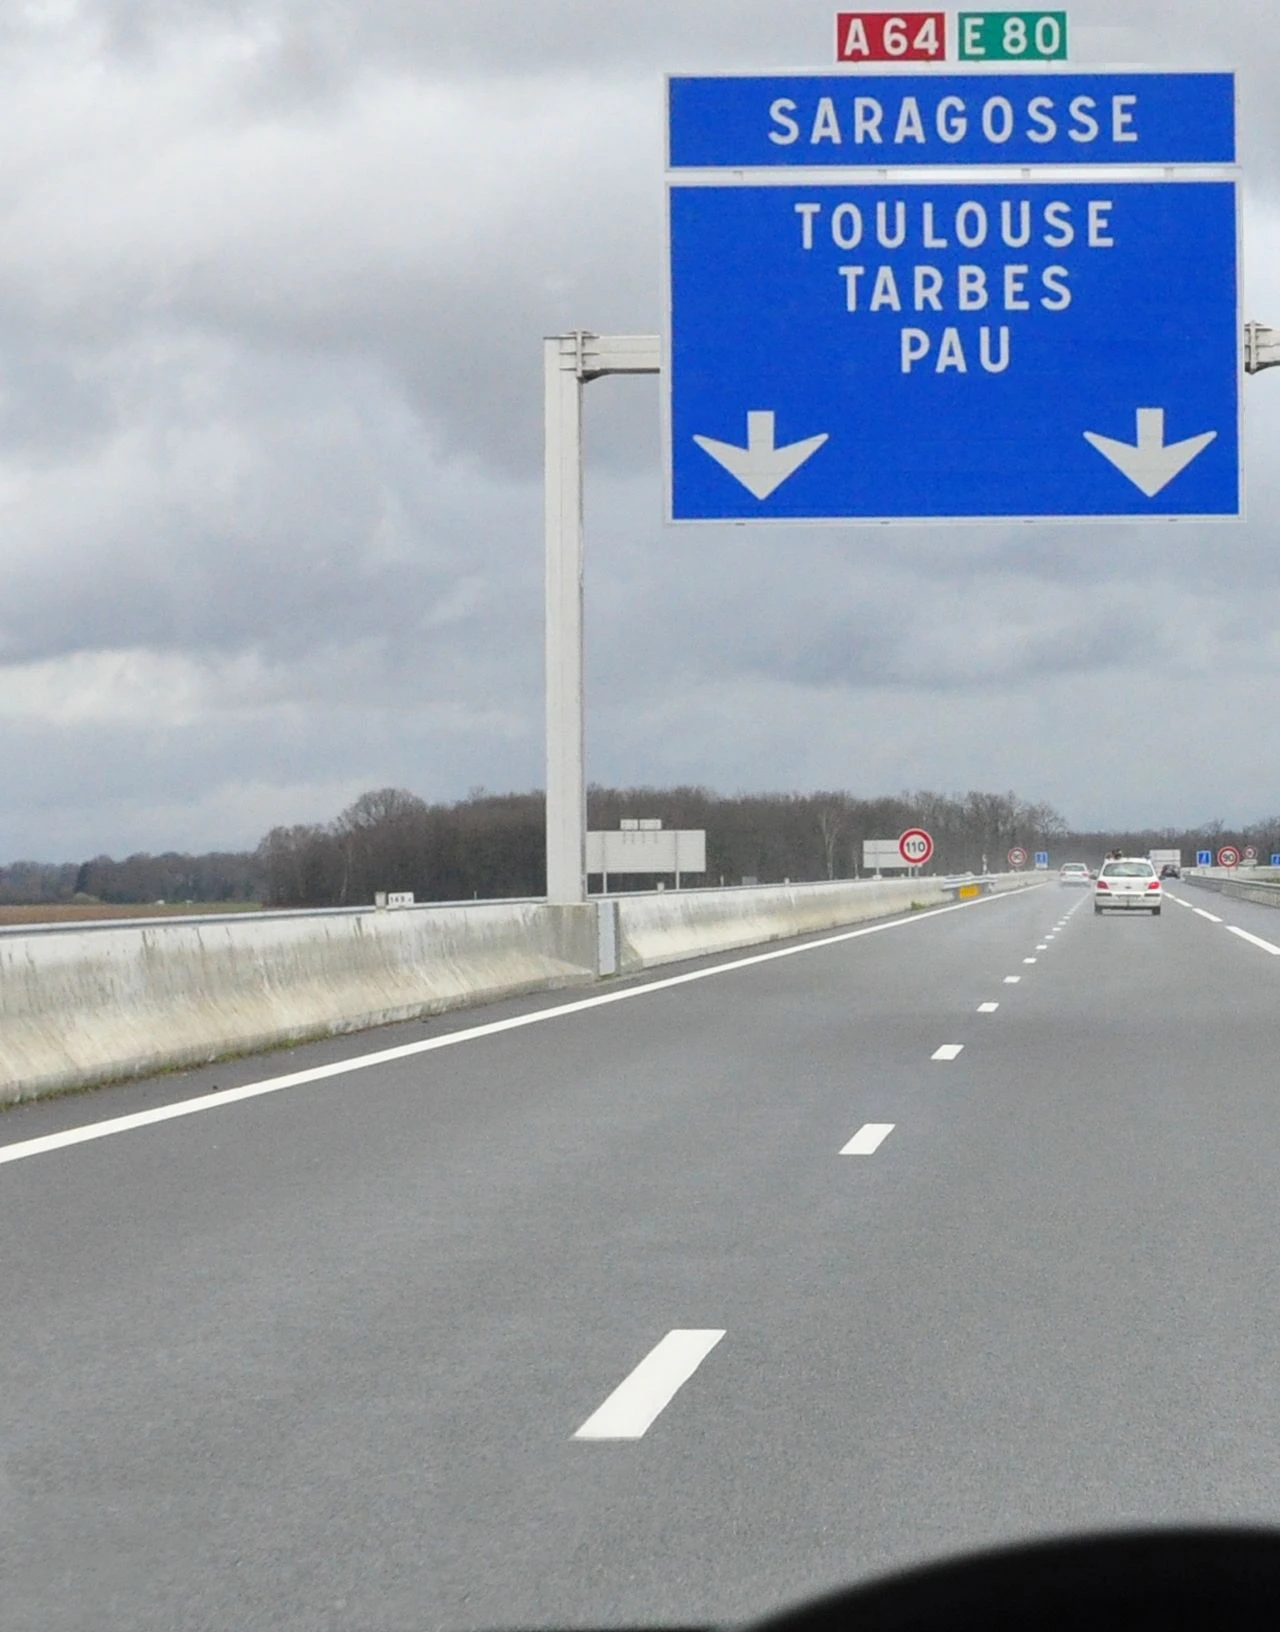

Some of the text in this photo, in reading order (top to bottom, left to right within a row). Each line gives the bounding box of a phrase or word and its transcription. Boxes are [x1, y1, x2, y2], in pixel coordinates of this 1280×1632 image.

[844, 17, 939, 56] A 64
[964, 16, 1060, 55] E 80
[768, 95, 1138, 145] SARAGOSSE
[794, 200, 1114, 250] TOULOUSE
[839, 264, 1072, 312] TARBES
[901, 326, 1009, 373] PAU
[906, 841, 926, 853] 110
